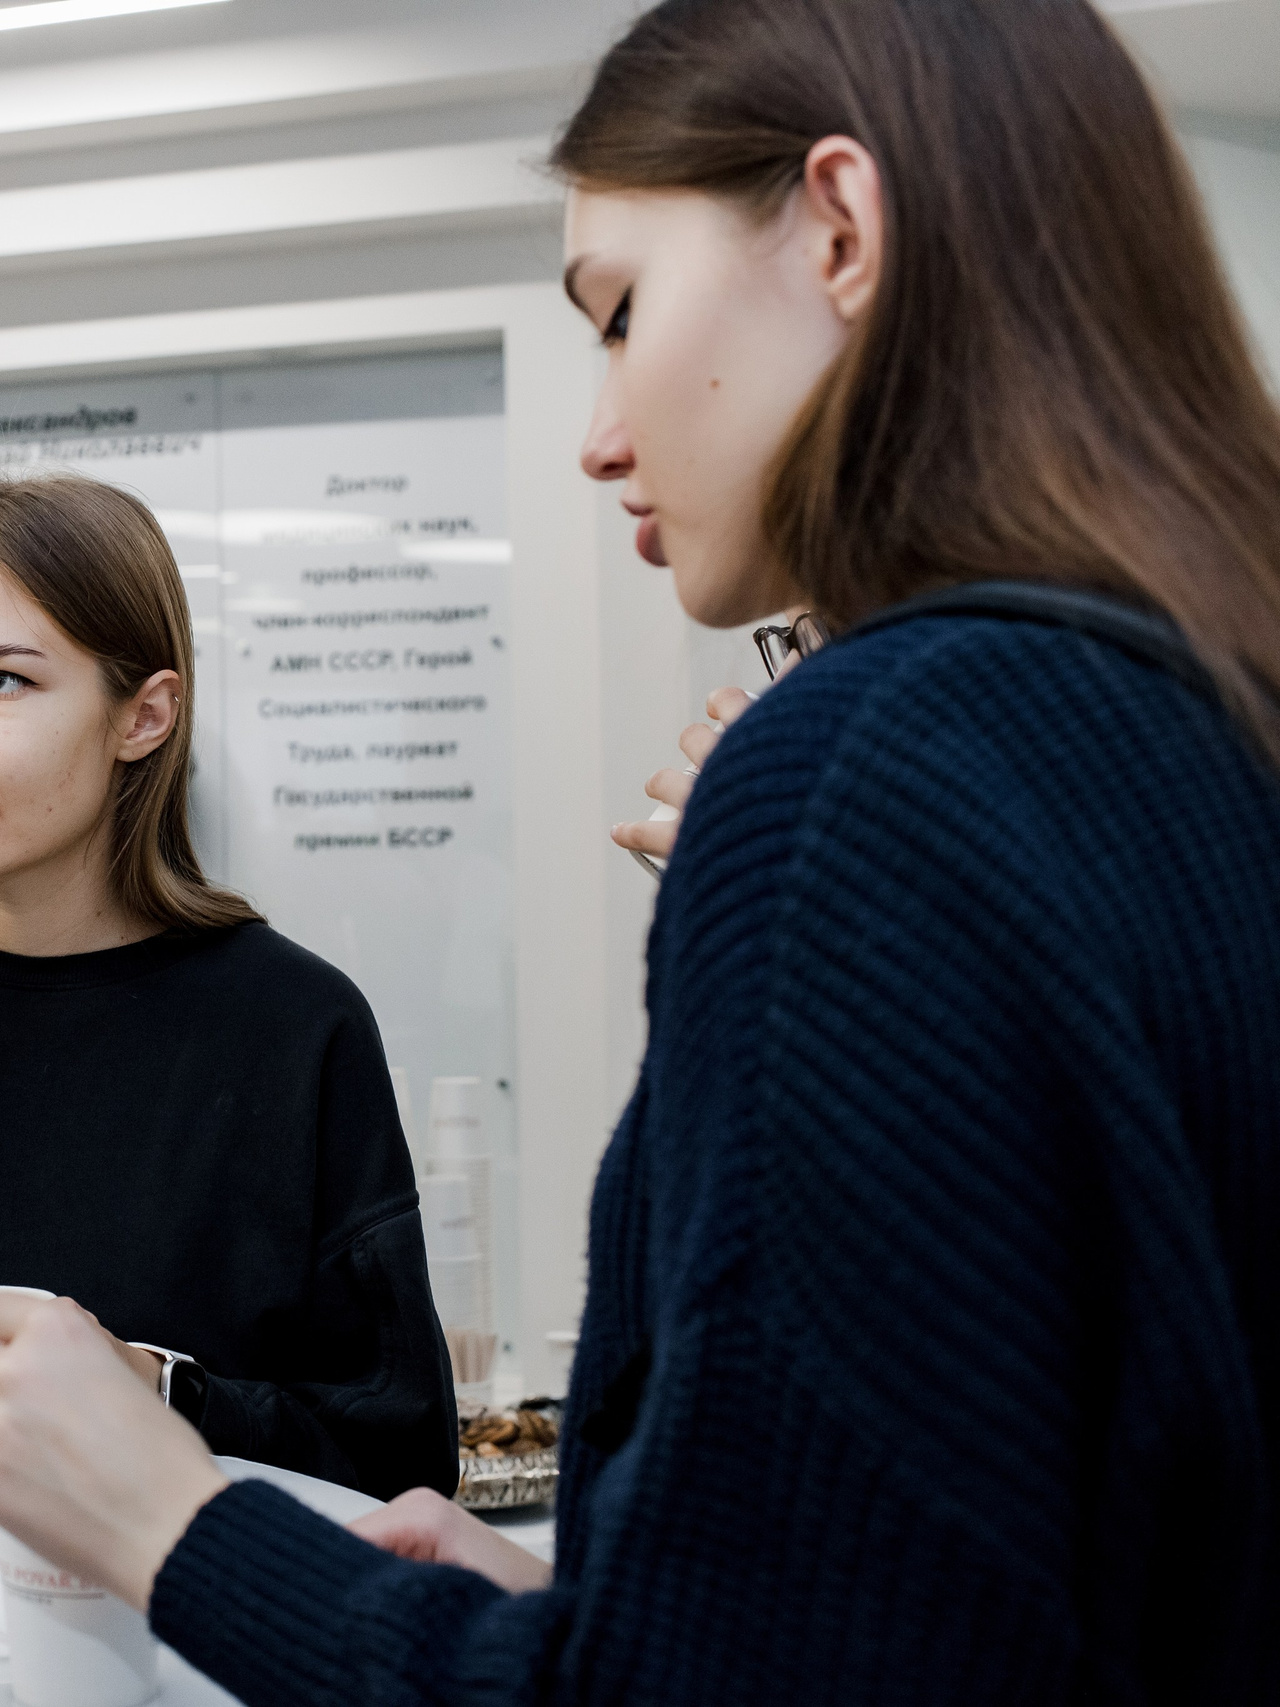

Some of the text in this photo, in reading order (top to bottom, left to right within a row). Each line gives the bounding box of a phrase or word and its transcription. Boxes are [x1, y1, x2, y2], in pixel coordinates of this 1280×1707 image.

[325, 475, 408, 497] Доктор
[302, 564, 436, 586] профессор,
[253, 605, 490, 628] член-корреспондент
[271, 655, 323, 673] АМН
[404, 648, 473, 670] Герой
[258, 696, 487, 719] Социалистического
[366, 740, 459, 762] лауреат
[273, 783, 474, 808] Государственной
[295, 828, 454, 852] премии БССР
